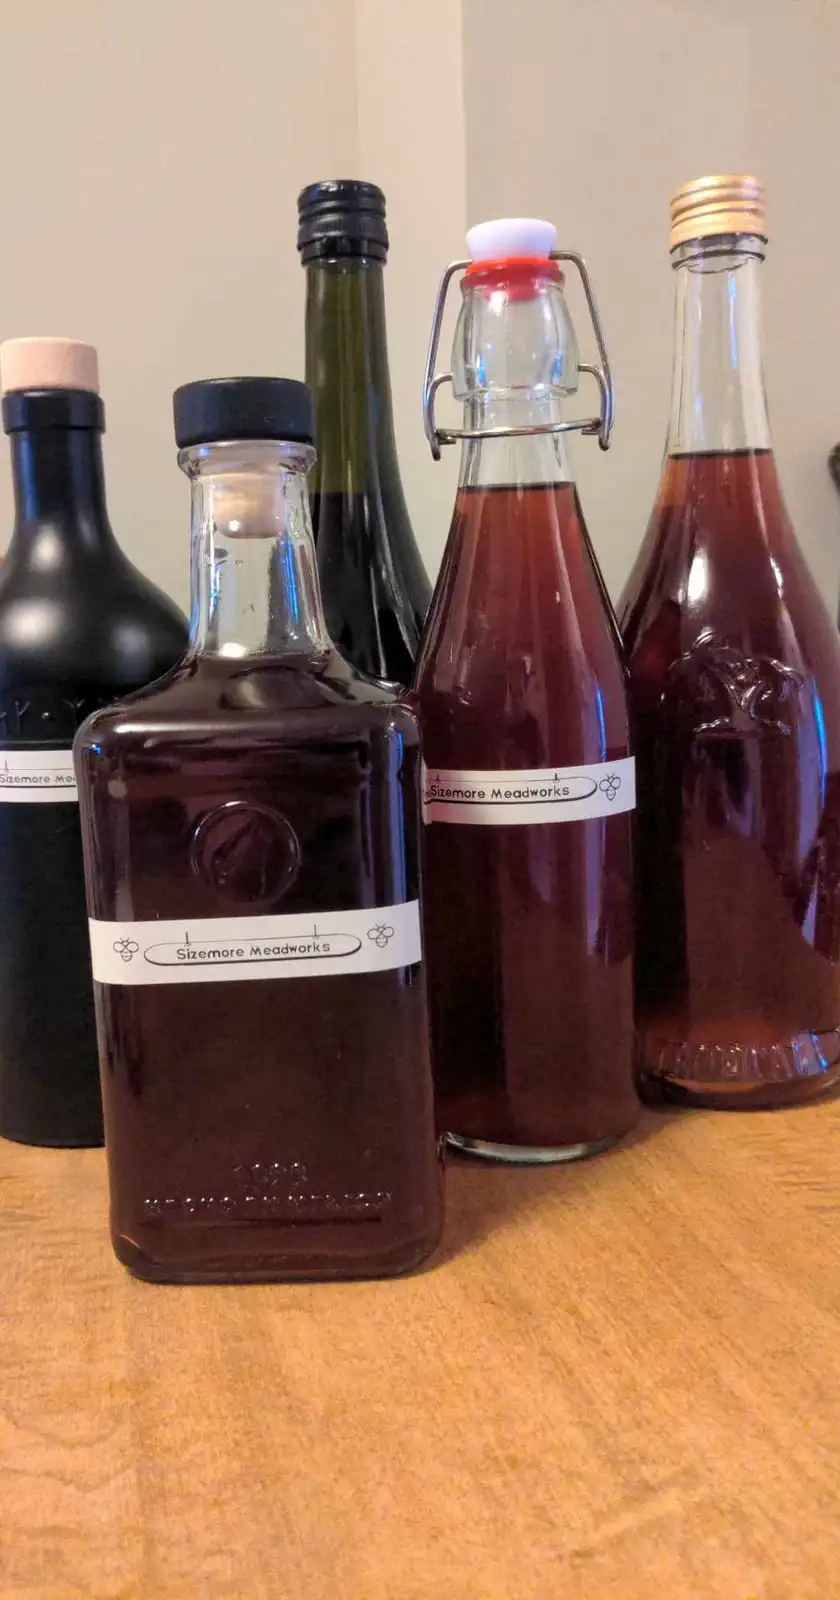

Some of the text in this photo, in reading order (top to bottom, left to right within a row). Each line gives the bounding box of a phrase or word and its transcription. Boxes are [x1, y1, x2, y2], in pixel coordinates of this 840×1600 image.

[0, 774, 50, 783] Sizemore
[430, 785, 570, 798] Sizemore Meadworks
[176, 941, 330, 960] Sizemore Meadworks
